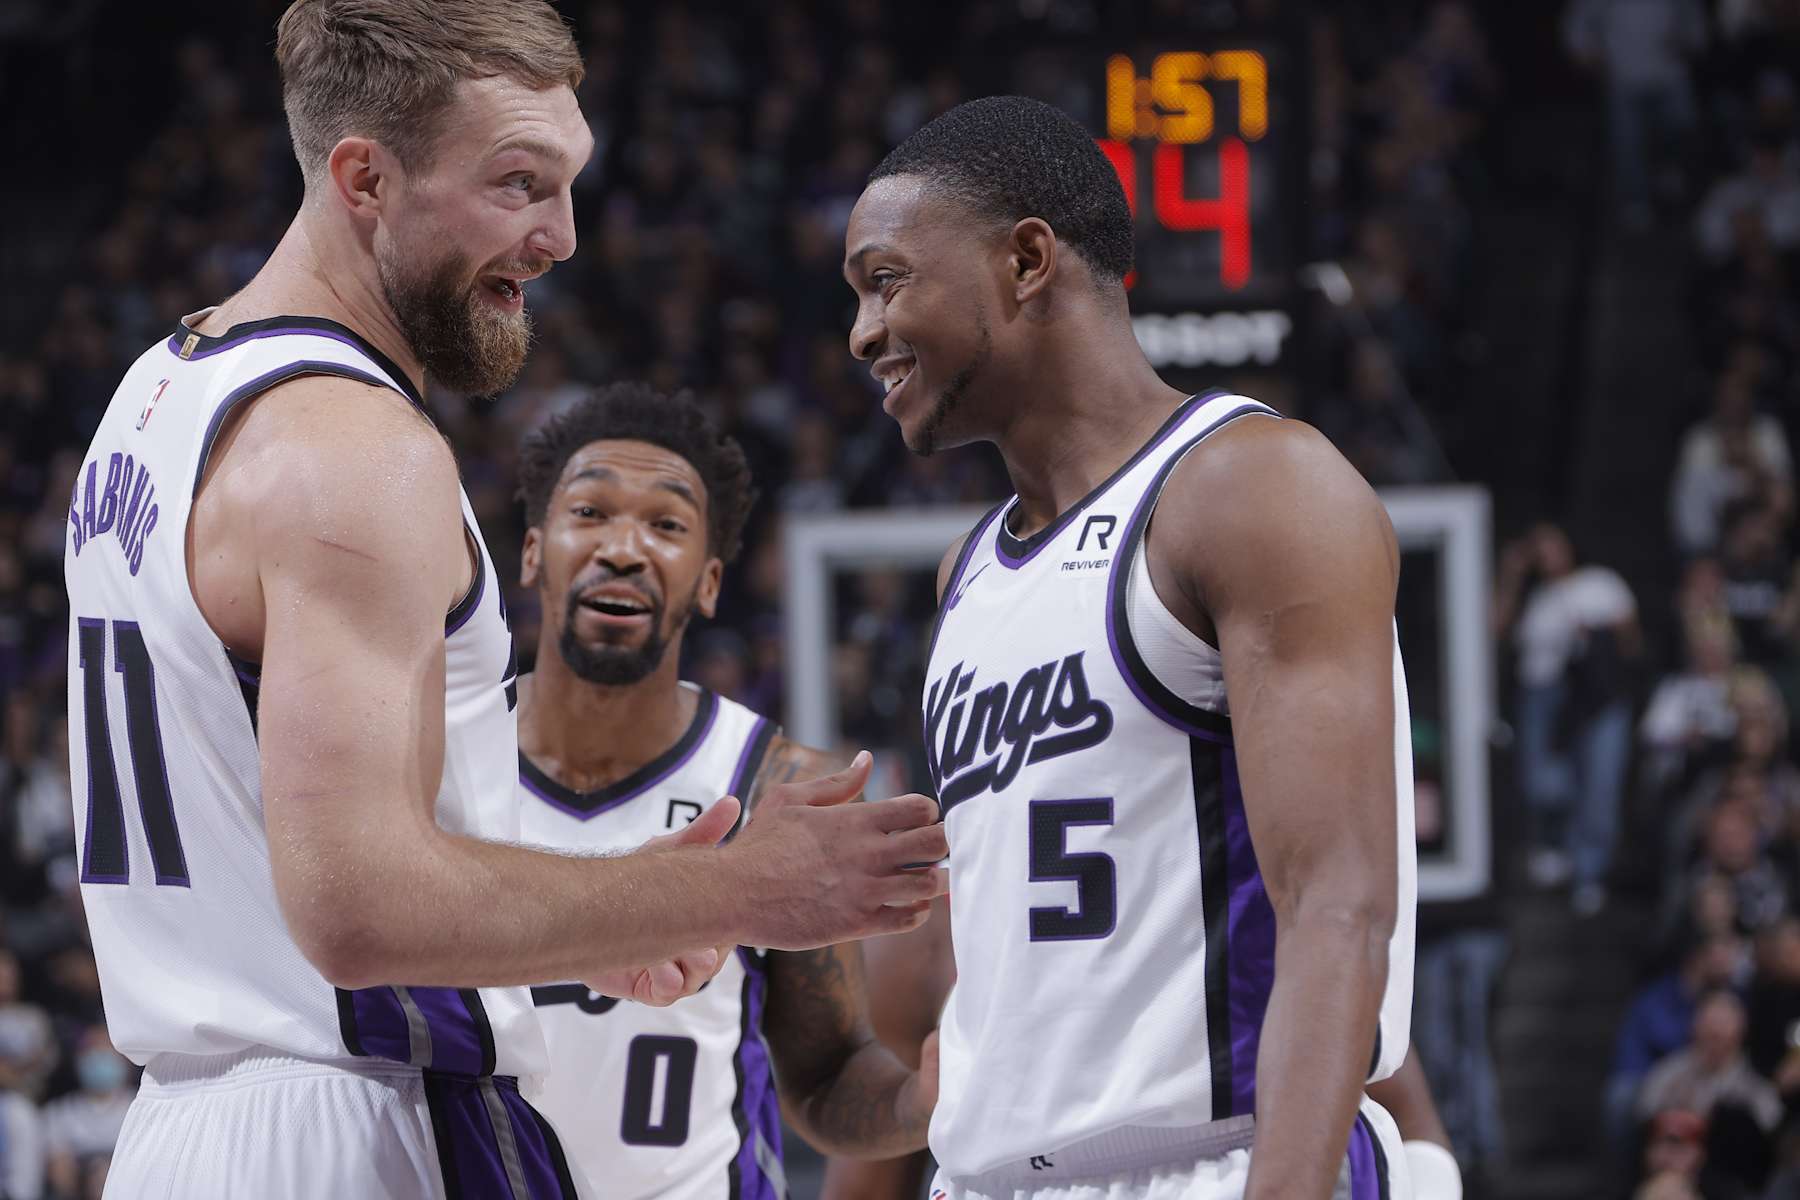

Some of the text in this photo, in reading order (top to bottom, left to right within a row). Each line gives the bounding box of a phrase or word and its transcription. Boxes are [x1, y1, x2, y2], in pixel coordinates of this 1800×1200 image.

[70, 452, 159, 577] SABONIS
[1061, 559, 1110, 571] REVIVER
[78, 616, 191, 888] 11
[922, 650, 1114, 822] Kings
[1028, 797, 1117, 942] 5
[620, 1034, 698, 1147] 0
